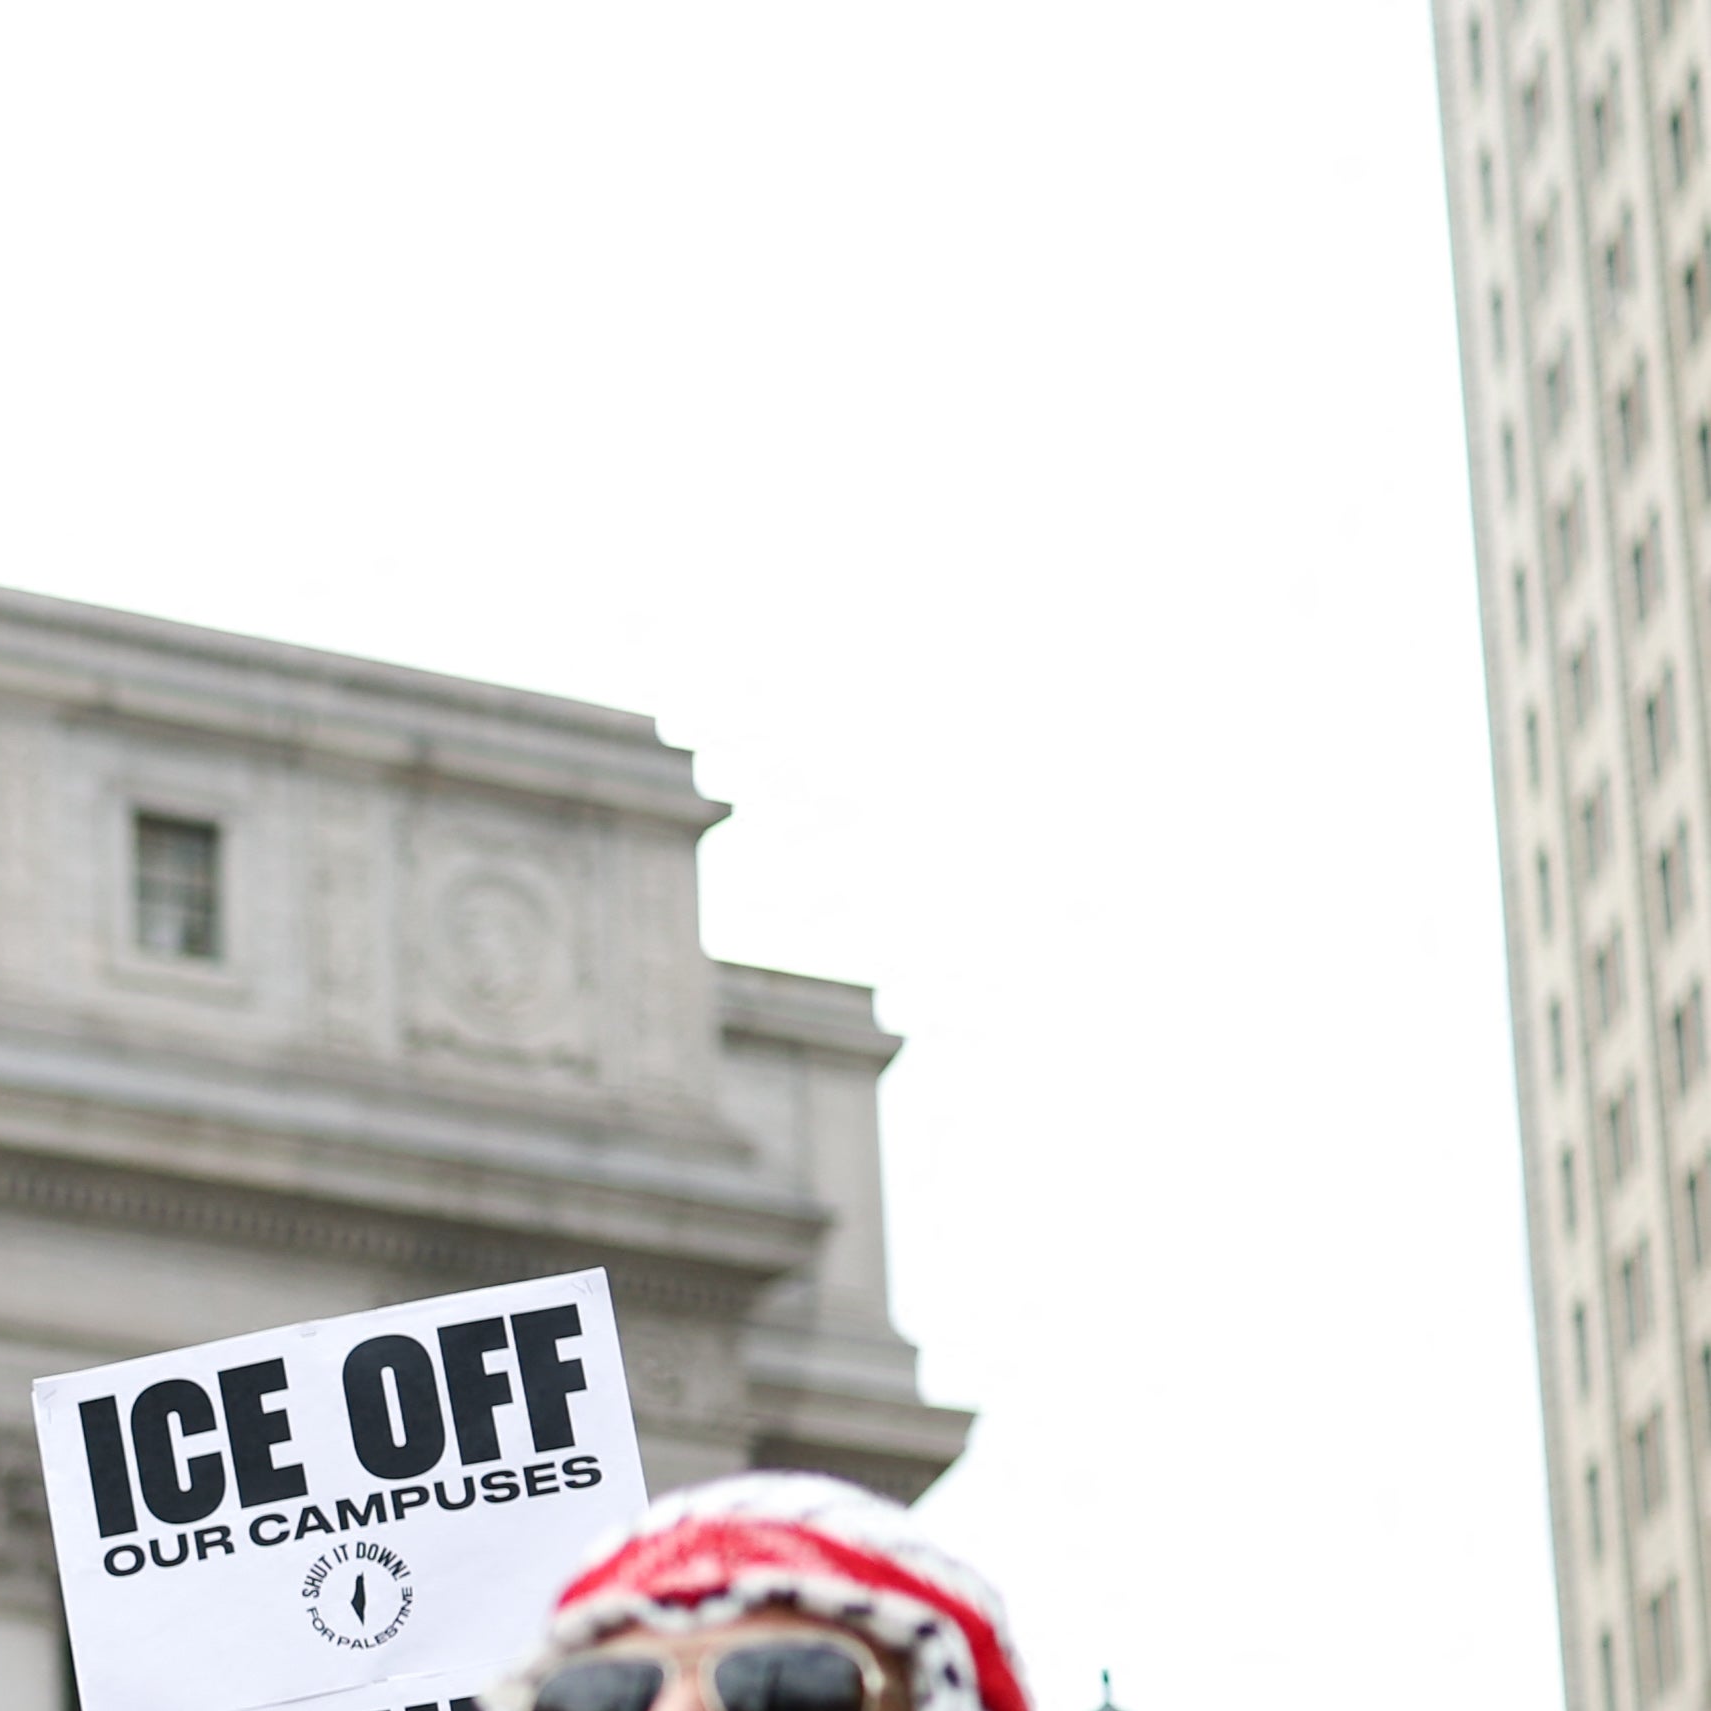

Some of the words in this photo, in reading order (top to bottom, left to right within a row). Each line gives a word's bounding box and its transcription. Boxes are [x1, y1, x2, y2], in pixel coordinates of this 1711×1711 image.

[78, 1356, 309, 1539] ICE
[342, 1302, 588, 1480] OFF
[102, 1525, 235, 1577] OUR
[249, 1454, 604, 1548] CAMPUSES
[301, 1554, 333, 1599] SHUT
[332, 1543, 350, 1564] IT
[355, 1541, 411, 1582] DOWN!
[306, 1606, 336, 1643] FOR
[336, 1586, 414, 1651] PALESTINE
